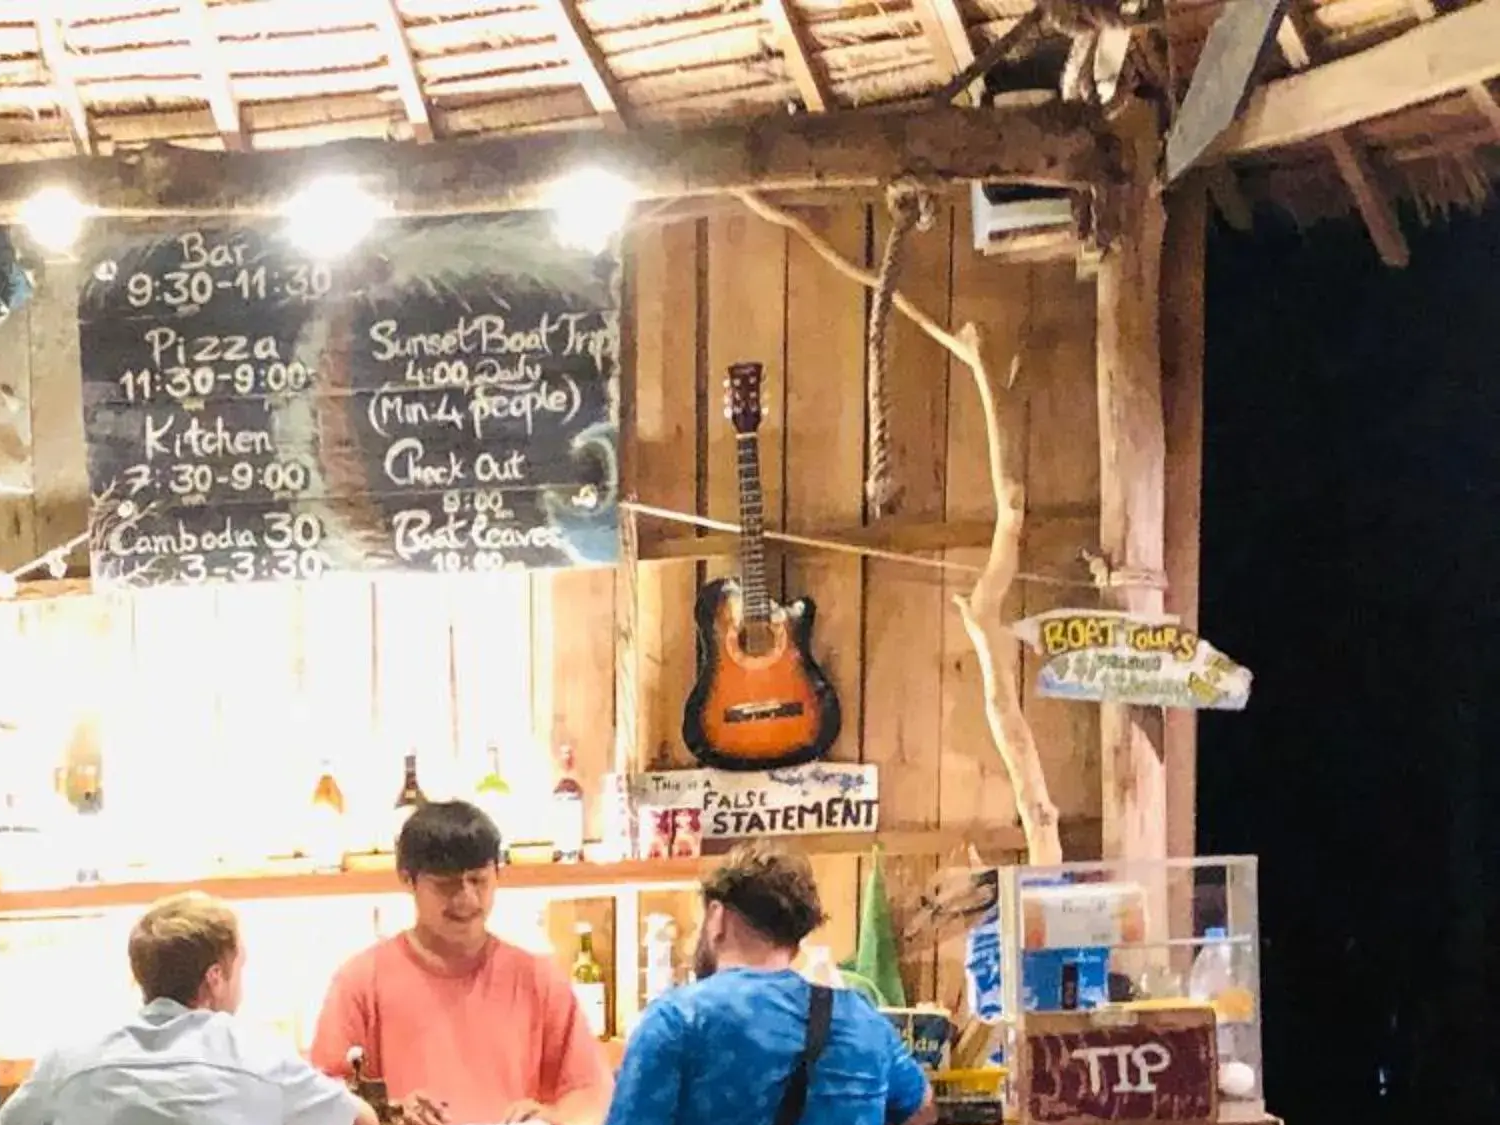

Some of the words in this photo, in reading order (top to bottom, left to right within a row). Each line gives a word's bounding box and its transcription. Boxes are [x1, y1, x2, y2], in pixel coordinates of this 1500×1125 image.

[177, 231, 249, 269] Bar
[144, 327, 281, 368] Pizza
[369, 315, 474, 361] Sunset
[474, 312, 553, 355] Boat
[467, 374, 581, 440] people)
[145, 415, 275, 461] Kitchen
[384, 437, 467, 486] Check
[474, 450, 526, 481] Out
[110, 519, 259, 556] Cambodia
[263, 511, 323, 549] 30
[392, 509, 469, 561] Boat
[1043, 617, 1119, 654] BOAT
[703, 790, 767, 811] FALSE
[712, 797, 879, 834] STATEMENT
[1072, 1042, 1172, 1095] TIP
